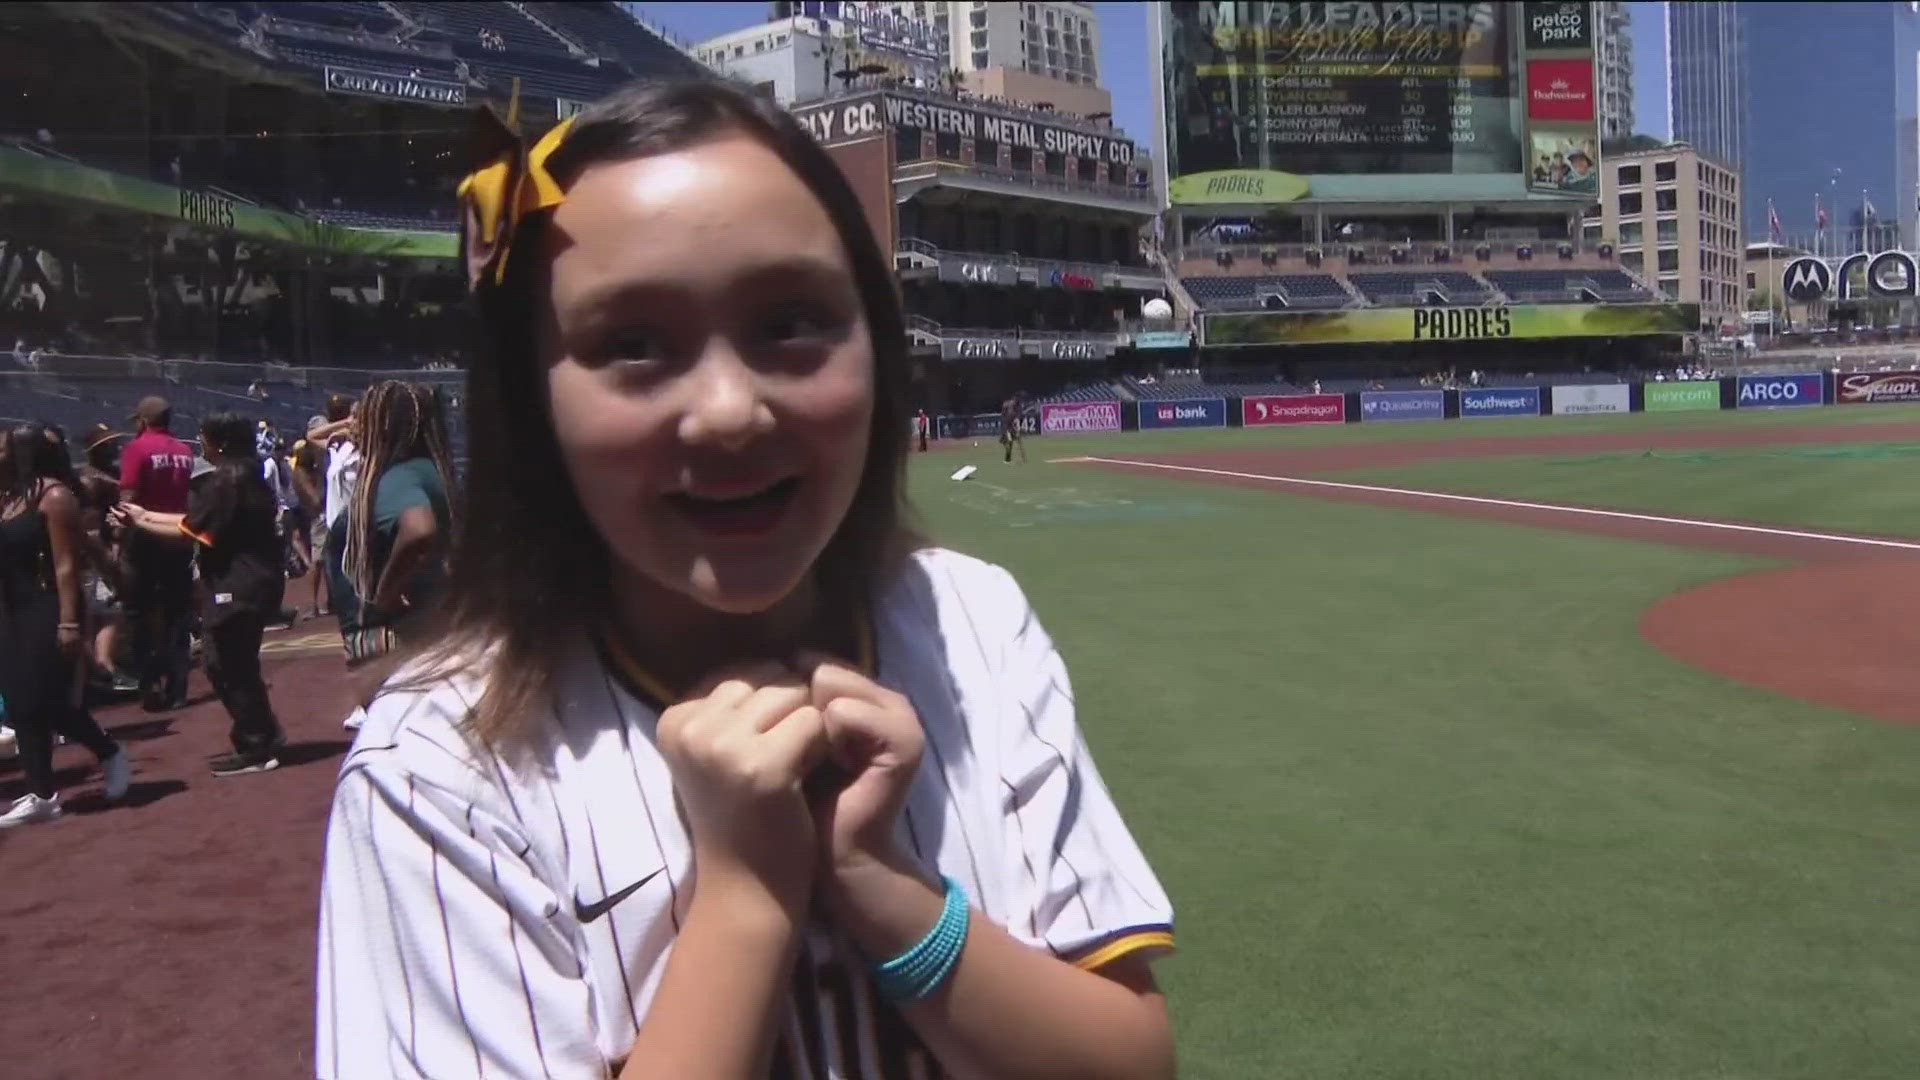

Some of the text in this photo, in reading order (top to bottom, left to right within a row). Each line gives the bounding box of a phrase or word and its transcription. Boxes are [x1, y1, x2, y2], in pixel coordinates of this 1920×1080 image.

[1300, 1, 1494, 30] LEADERS
[1533, 13, 1581, 31] petco
[1542, 27, 1581, 43] park
[1401, 77, 1424, 88] ATL
[1264, 104, 1304, 115] TYLER
[1304, 104, 1367, 115] GLASNOW
[1401, 104, 1425, 115] LAD
[843, 101, 883, 135] CO.
[1264, 118, 1307, 129] SONNY
[1309, 118, 1341, 129] GRAY
[885, 98, 1134, 165] WESTERN METAL SUPPLY CO.
[1265, 131, 1313, 144] FREDDY
[1314, 131, 1367, 144] PERALTA
[1207, 174, 1265, 197] PADRES
[180, 191, 234, 229] PADRES
[1414, 307, 1511, 339] PADRES
[1740, 382, 1798, 401] ARCO
[1464, 395, 1526, 410] Southwest
[1158, 405, 1206, 419] us bank
[1272, 403, 1338, 418] Snapdragon
[1013, 417, 1036, 432] 342
[1043, 417, 1119, 431] CALIFORNIA
